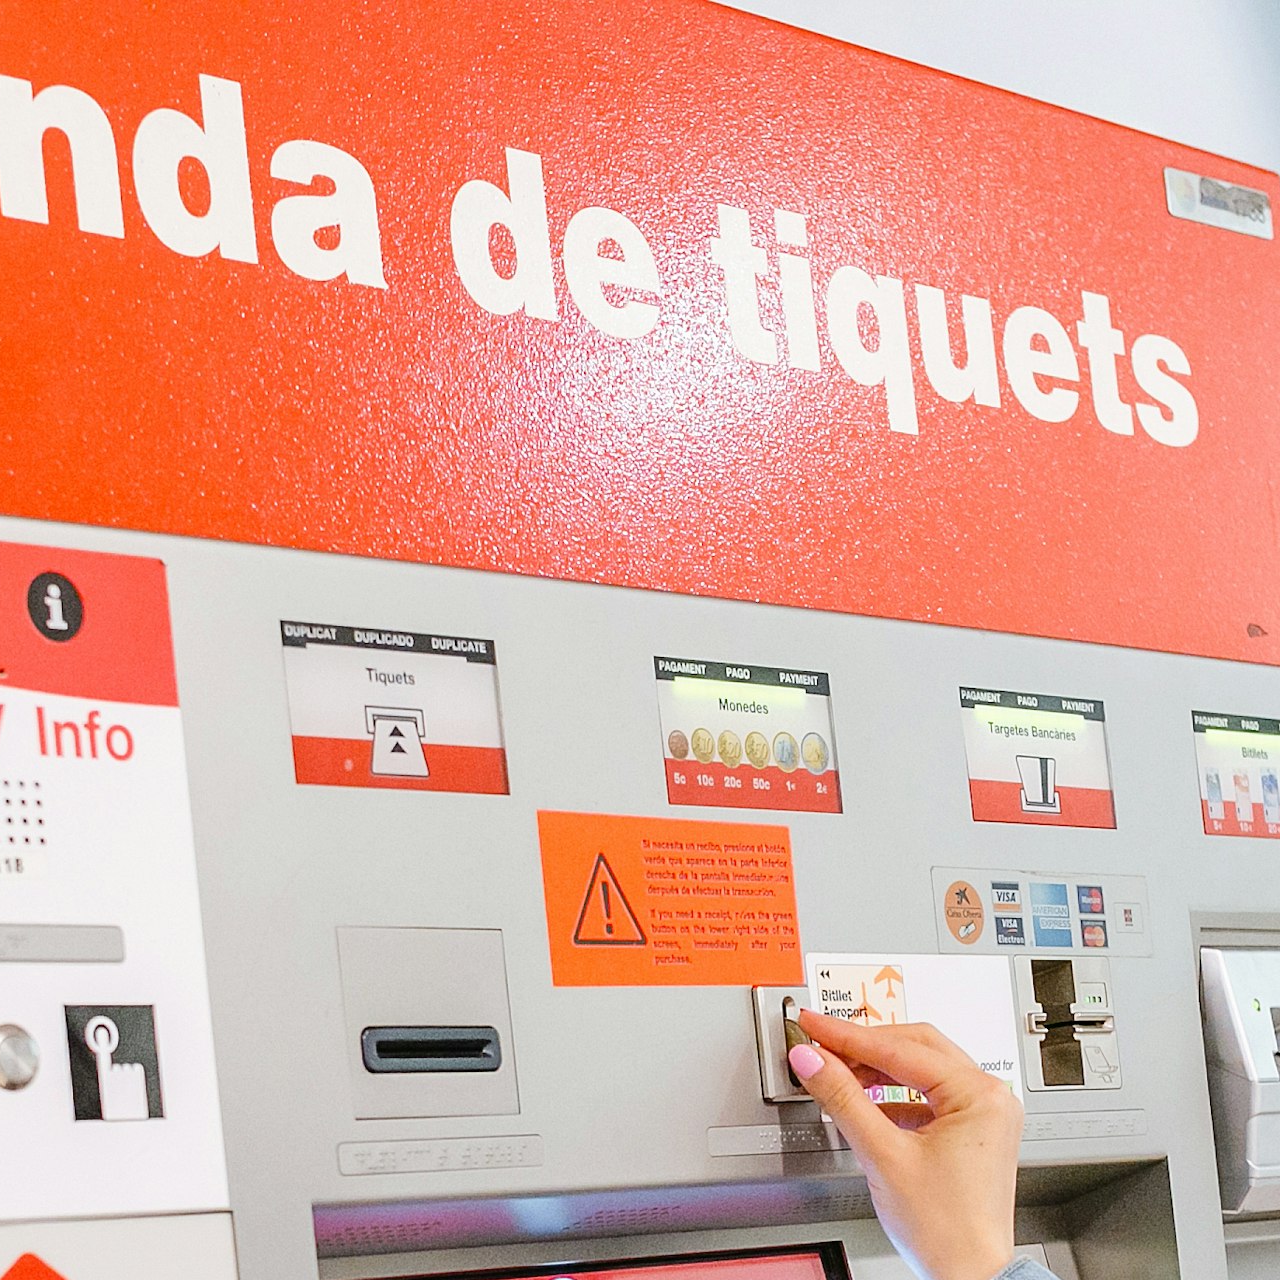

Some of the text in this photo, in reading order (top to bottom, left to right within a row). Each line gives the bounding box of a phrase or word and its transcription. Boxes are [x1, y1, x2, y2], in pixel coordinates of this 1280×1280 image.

[450, 148, 660, 339] de
[710, 203, 1200, 447] tiquets
[284, 624, 487, 654] DUPLICAT DUPLICADO DUPLICATE
[366, 667, 415, 686] Tiquets
[659, 660, 818, 686] PAGAMENT PAGO PAYMENT
[719, 698, 769, 714] Monedes
[961, 689, 1095, 713] PAGAMENT PAGO PAYMENT
[36, 706, 135, 763] Info
[988, 721, 1076, 741] Targetes Bancàries
[697, 774, 714, 786] 10c
[724, 776, 742, 788] 20c
[753, 778, 770, 790] 50c
[996, 891, 1016, 902] VISA
[1033, 906, 1067, 915] AMERICAN
[1002, 919, 1018, 928] VISA
[1041, 919, 1071, 928] EXPRESS
[998, 934, 1024, 944] Electron
[822, 990, 852, 1002] Bitllet
[823, 1006, 867, 1020] Aeroport
[980, 1059, 1014, 1075] good for
[888, 1089, 902, 1100] L3
[909, 1089, 921, 1102] L4
